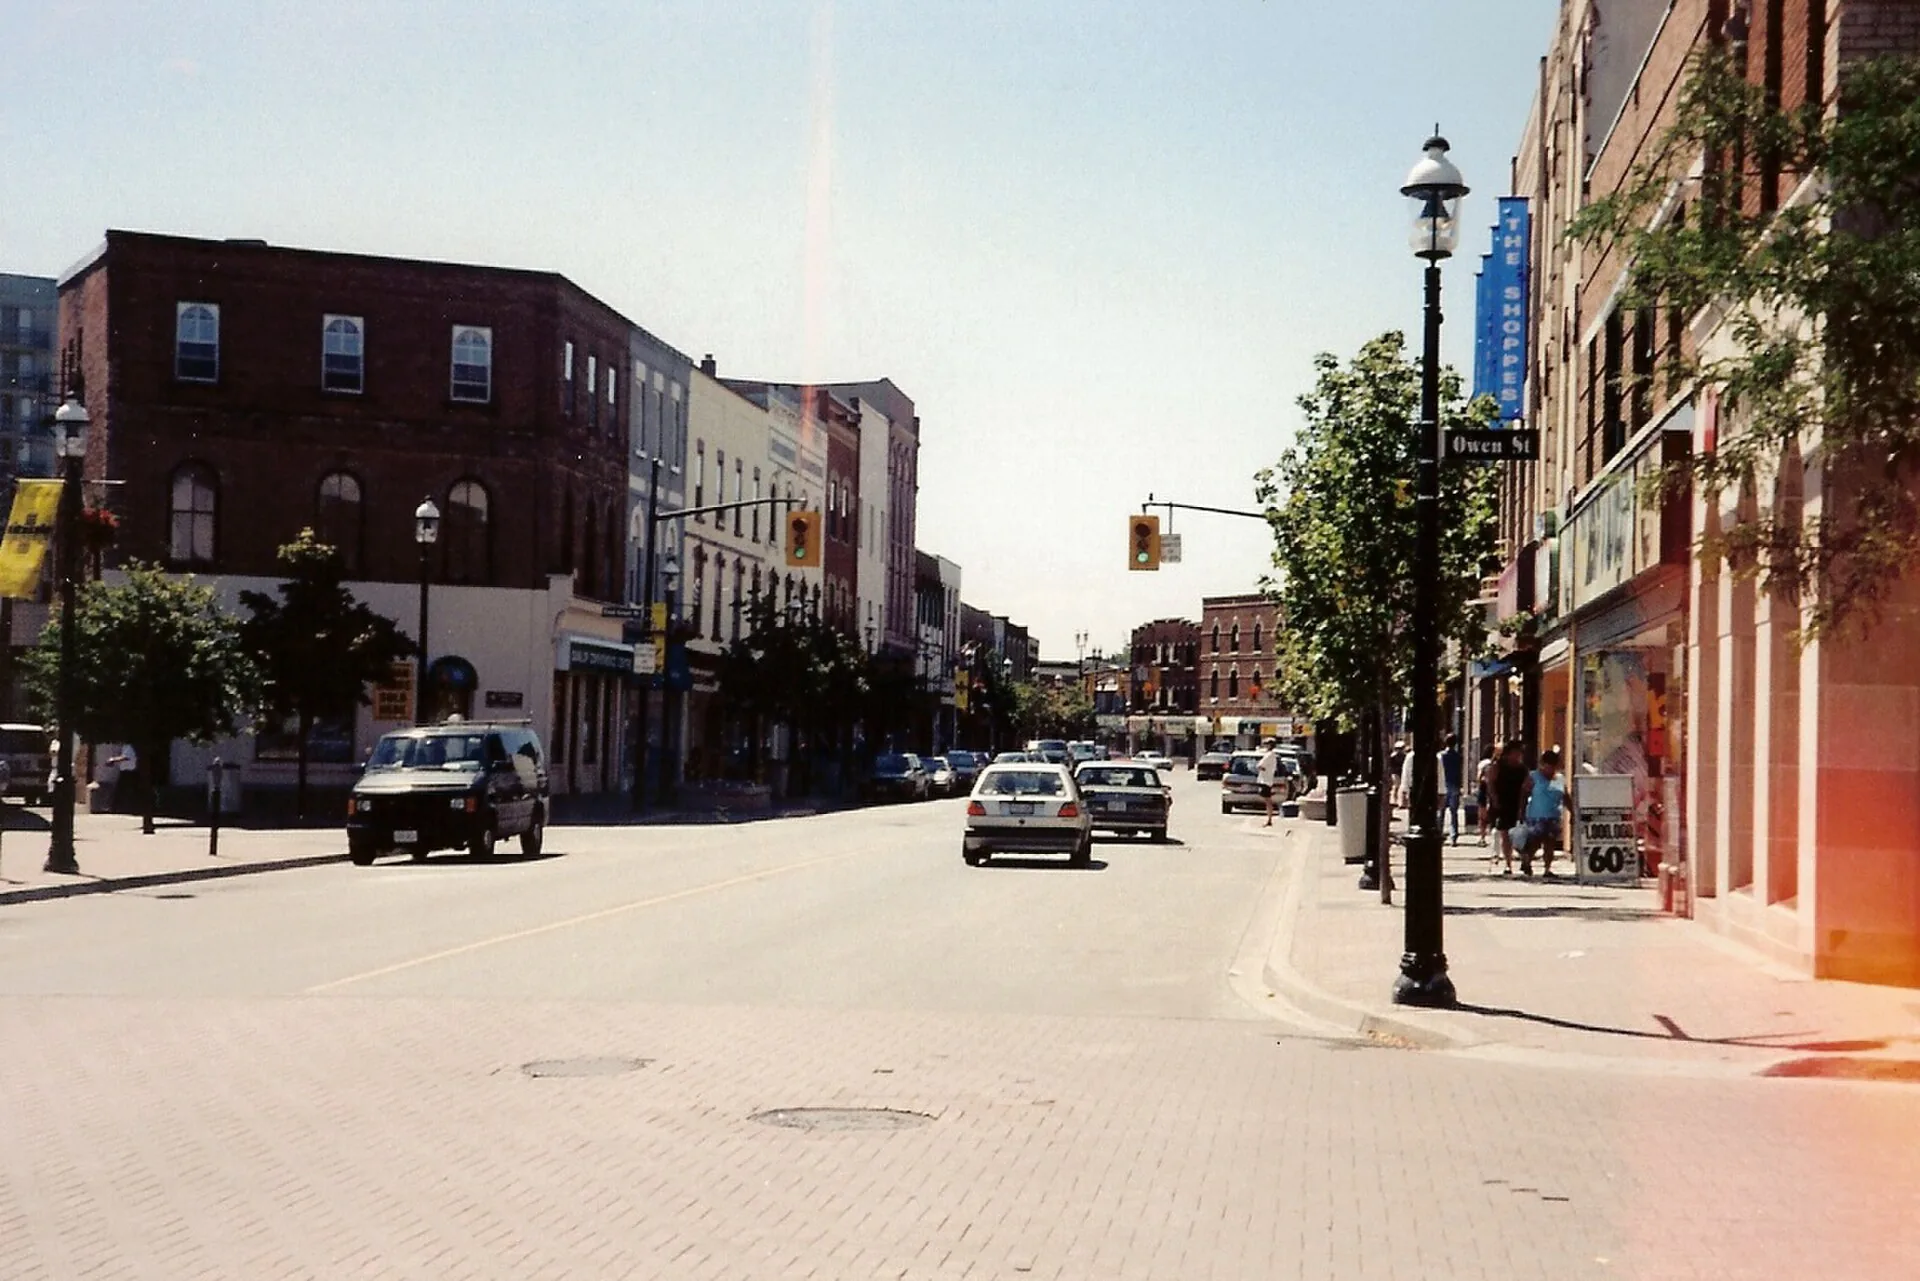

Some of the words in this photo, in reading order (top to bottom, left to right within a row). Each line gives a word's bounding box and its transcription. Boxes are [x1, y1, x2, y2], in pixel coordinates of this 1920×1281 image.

[1503, 217, 1522, 265] THE
[1501, 286, 1521, 401] SHOPPES
[1452, 435, 1503, 454] Owen
[1511, 434, 1530, 455] St
